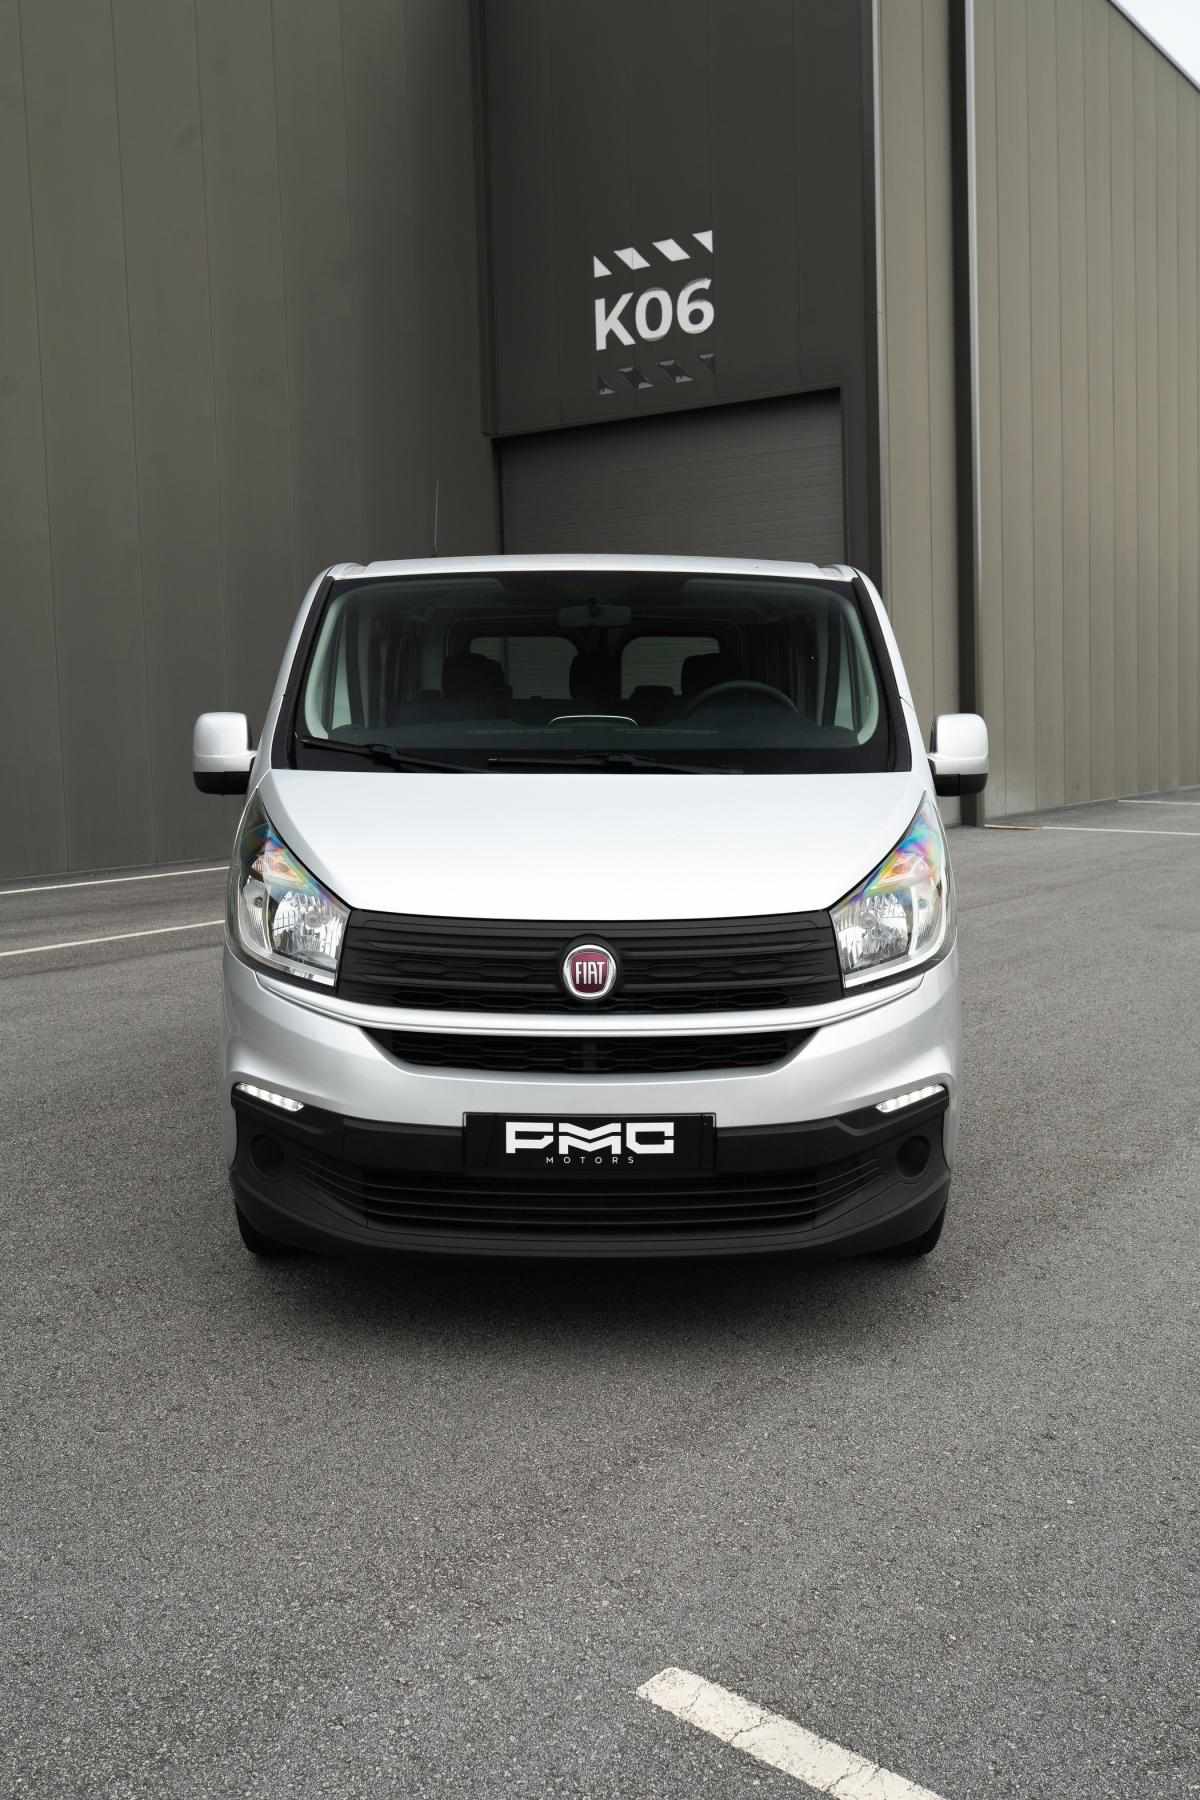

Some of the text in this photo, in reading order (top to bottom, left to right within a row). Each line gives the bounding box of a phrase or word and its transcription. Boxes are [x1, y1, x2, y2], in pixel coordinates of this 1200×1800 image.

[594, 277, 715, 351] K06
[575, 961, 605, 985] FIAT
[505, 1121, 675, 1155] PMC
[545, 1156, 635, 1165] MOTORS
